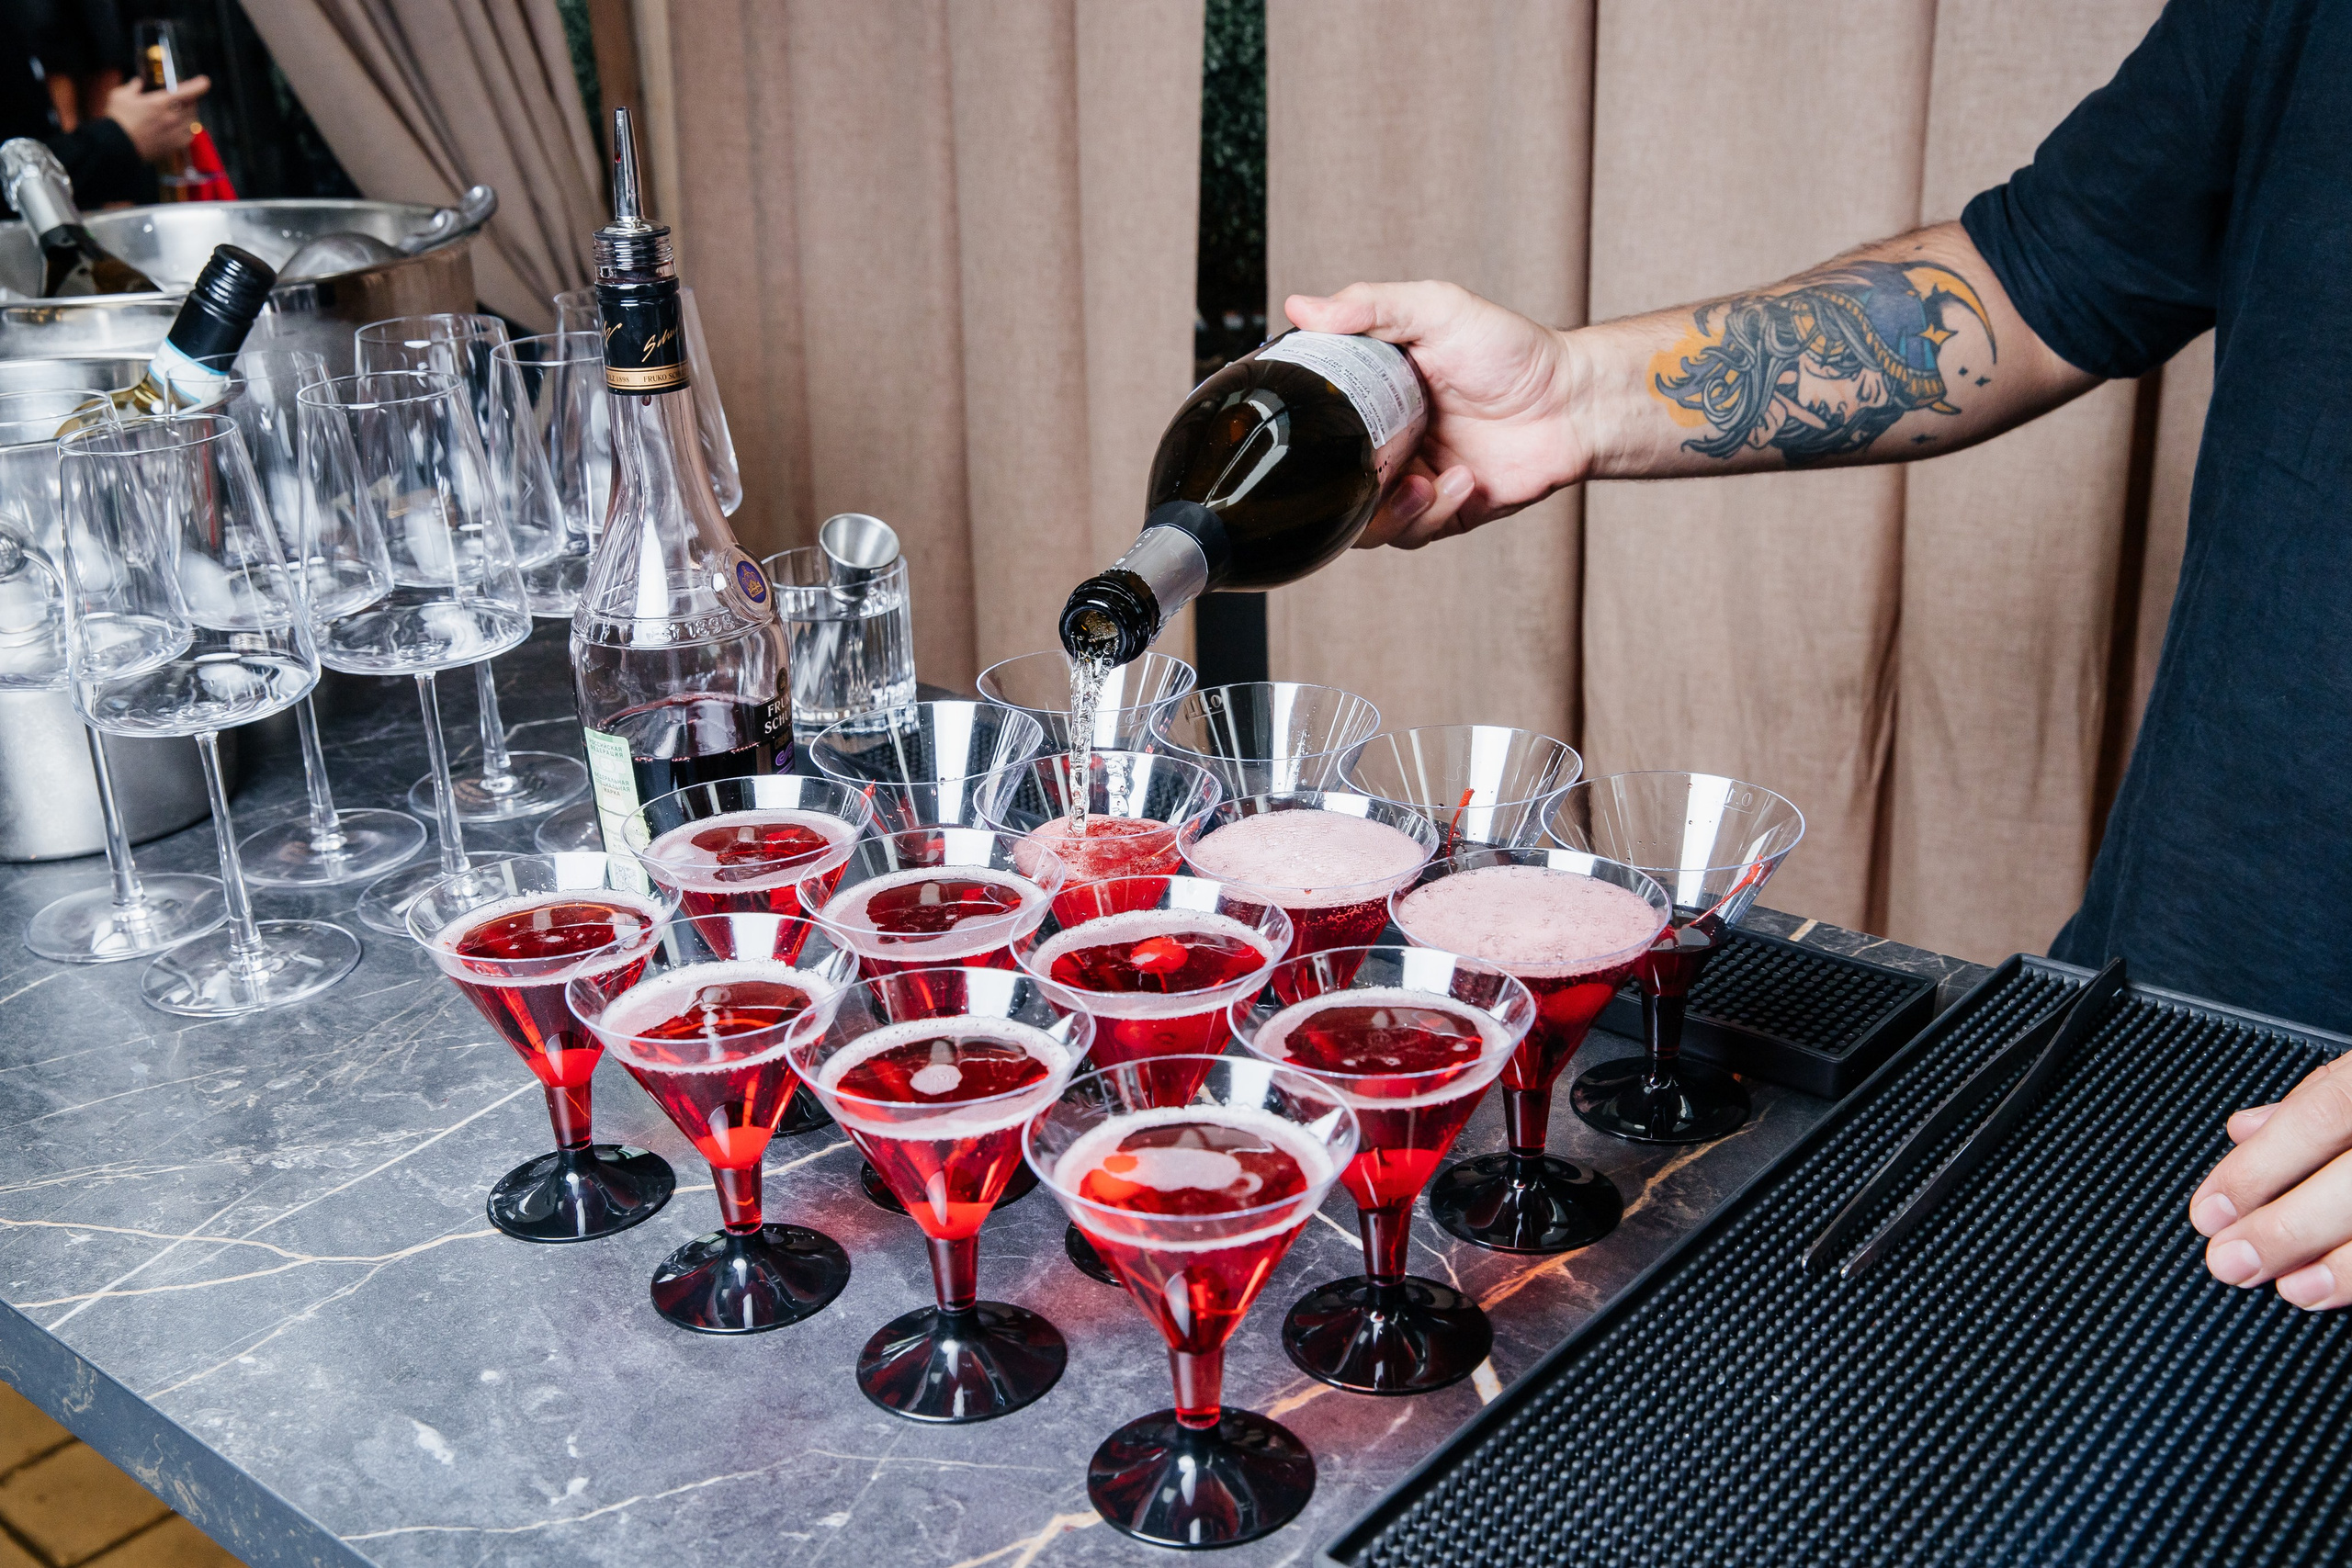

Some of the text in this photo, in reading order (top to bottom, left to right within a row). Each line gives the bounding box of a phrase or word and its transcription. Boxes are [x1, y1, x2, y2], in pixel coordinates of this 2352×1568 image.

[1324, 356, 1344, 369] 2021
[643, 373, 667, 383] FRUKO
[684, 613, 736, 638] 1898
[603, 787, 621, 796] МАРКА
